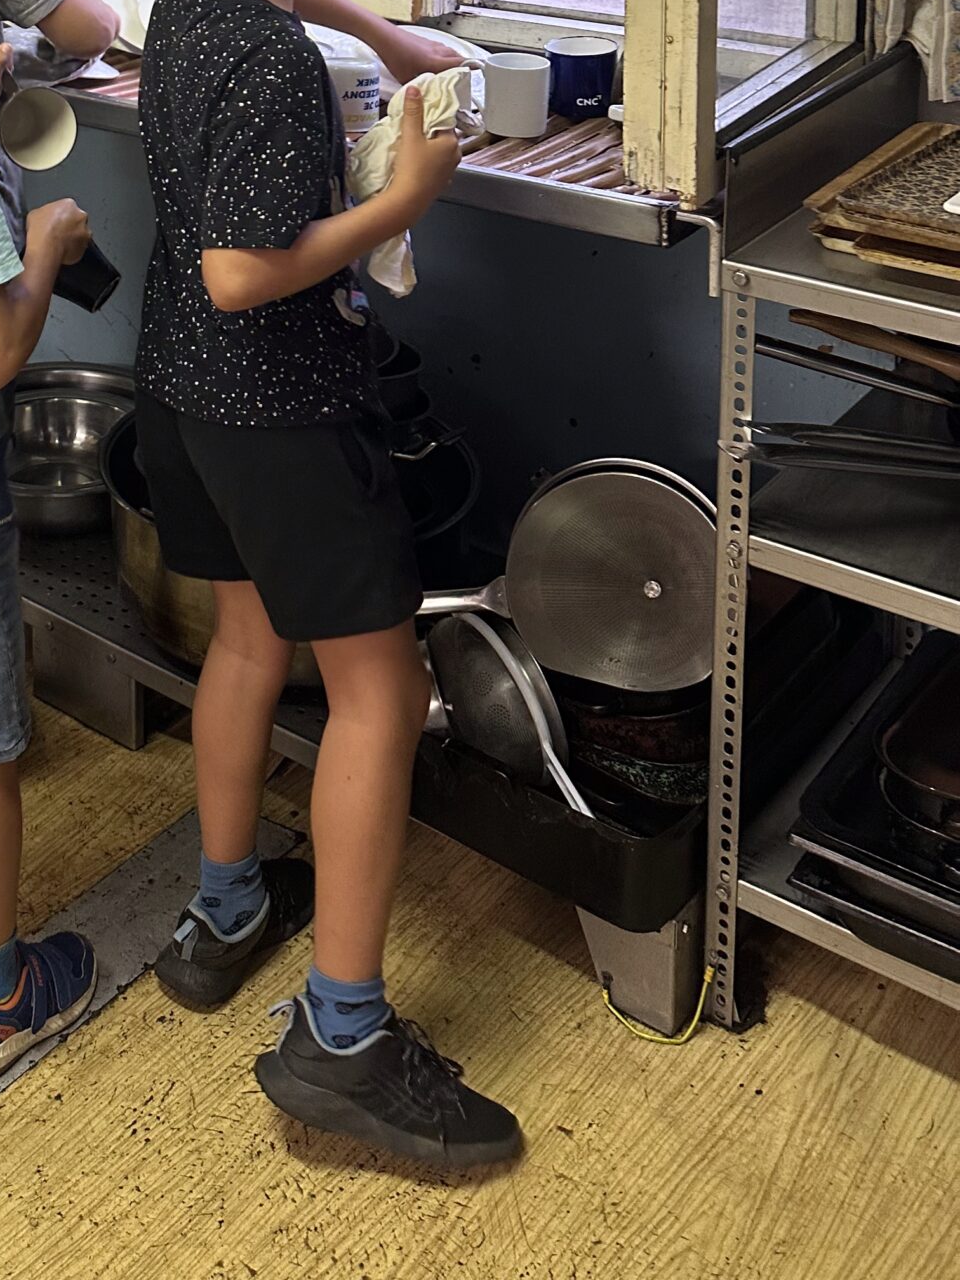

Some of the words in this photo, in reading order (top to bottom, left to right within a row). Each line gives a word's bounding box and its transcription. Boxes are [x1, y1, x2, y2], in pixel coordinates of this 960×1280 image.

[342, 88, 379, 101] EZEDNÝ
[363, 101, 373, 110] JE
[576, 97, 600, 106] CNC
